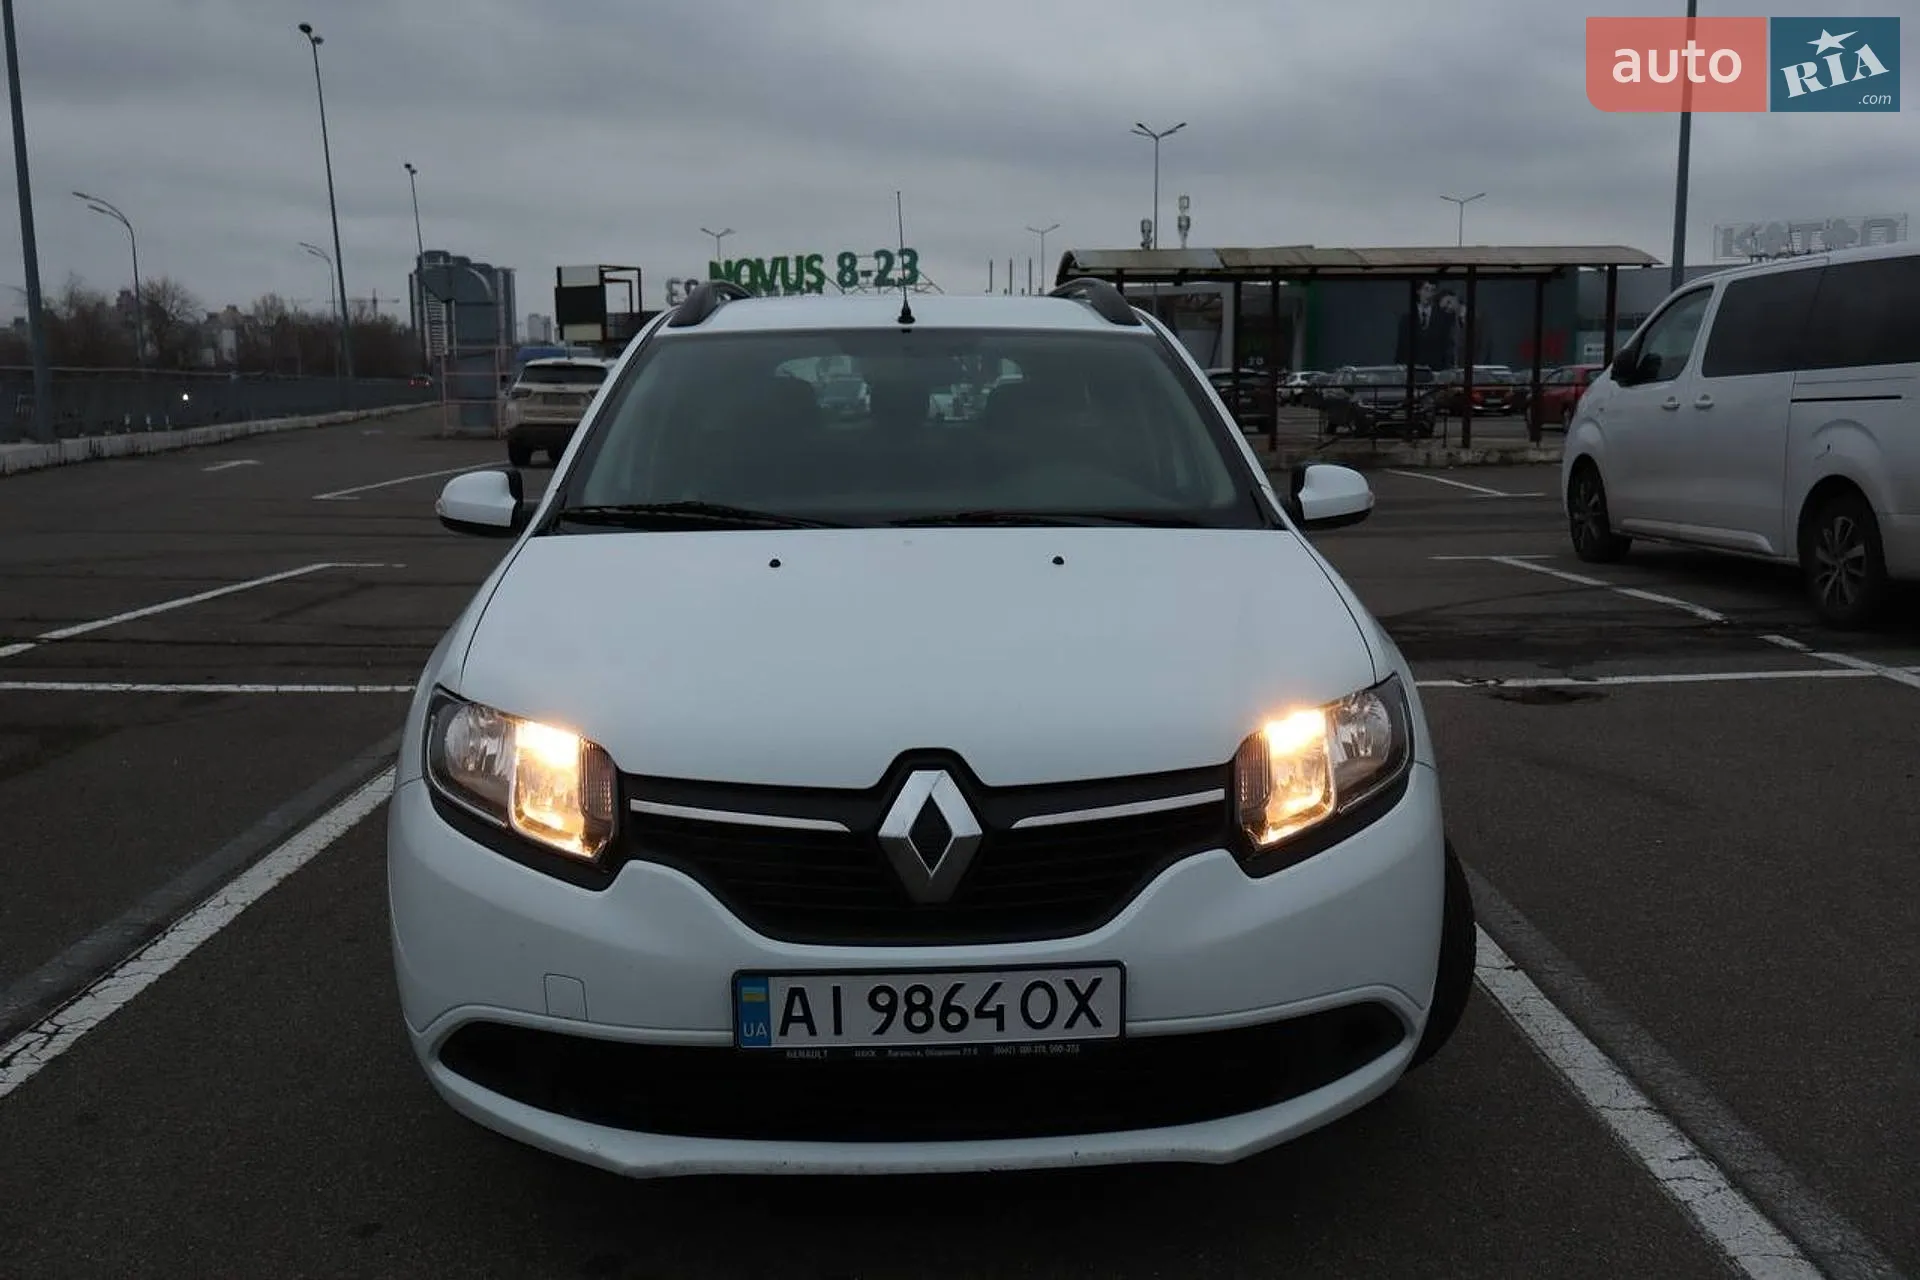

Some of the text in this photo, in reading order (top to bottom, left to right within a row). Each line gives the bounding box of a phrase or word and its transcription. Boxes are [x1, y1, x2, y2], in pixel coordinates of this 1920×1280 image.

[709, 254, 825, 294] NOVUS
[837, 248, 918, 287] 8-23
[779, 977, 1102, 1036] AI 9864 OX
[743, 1024, 768, 1038] UA
